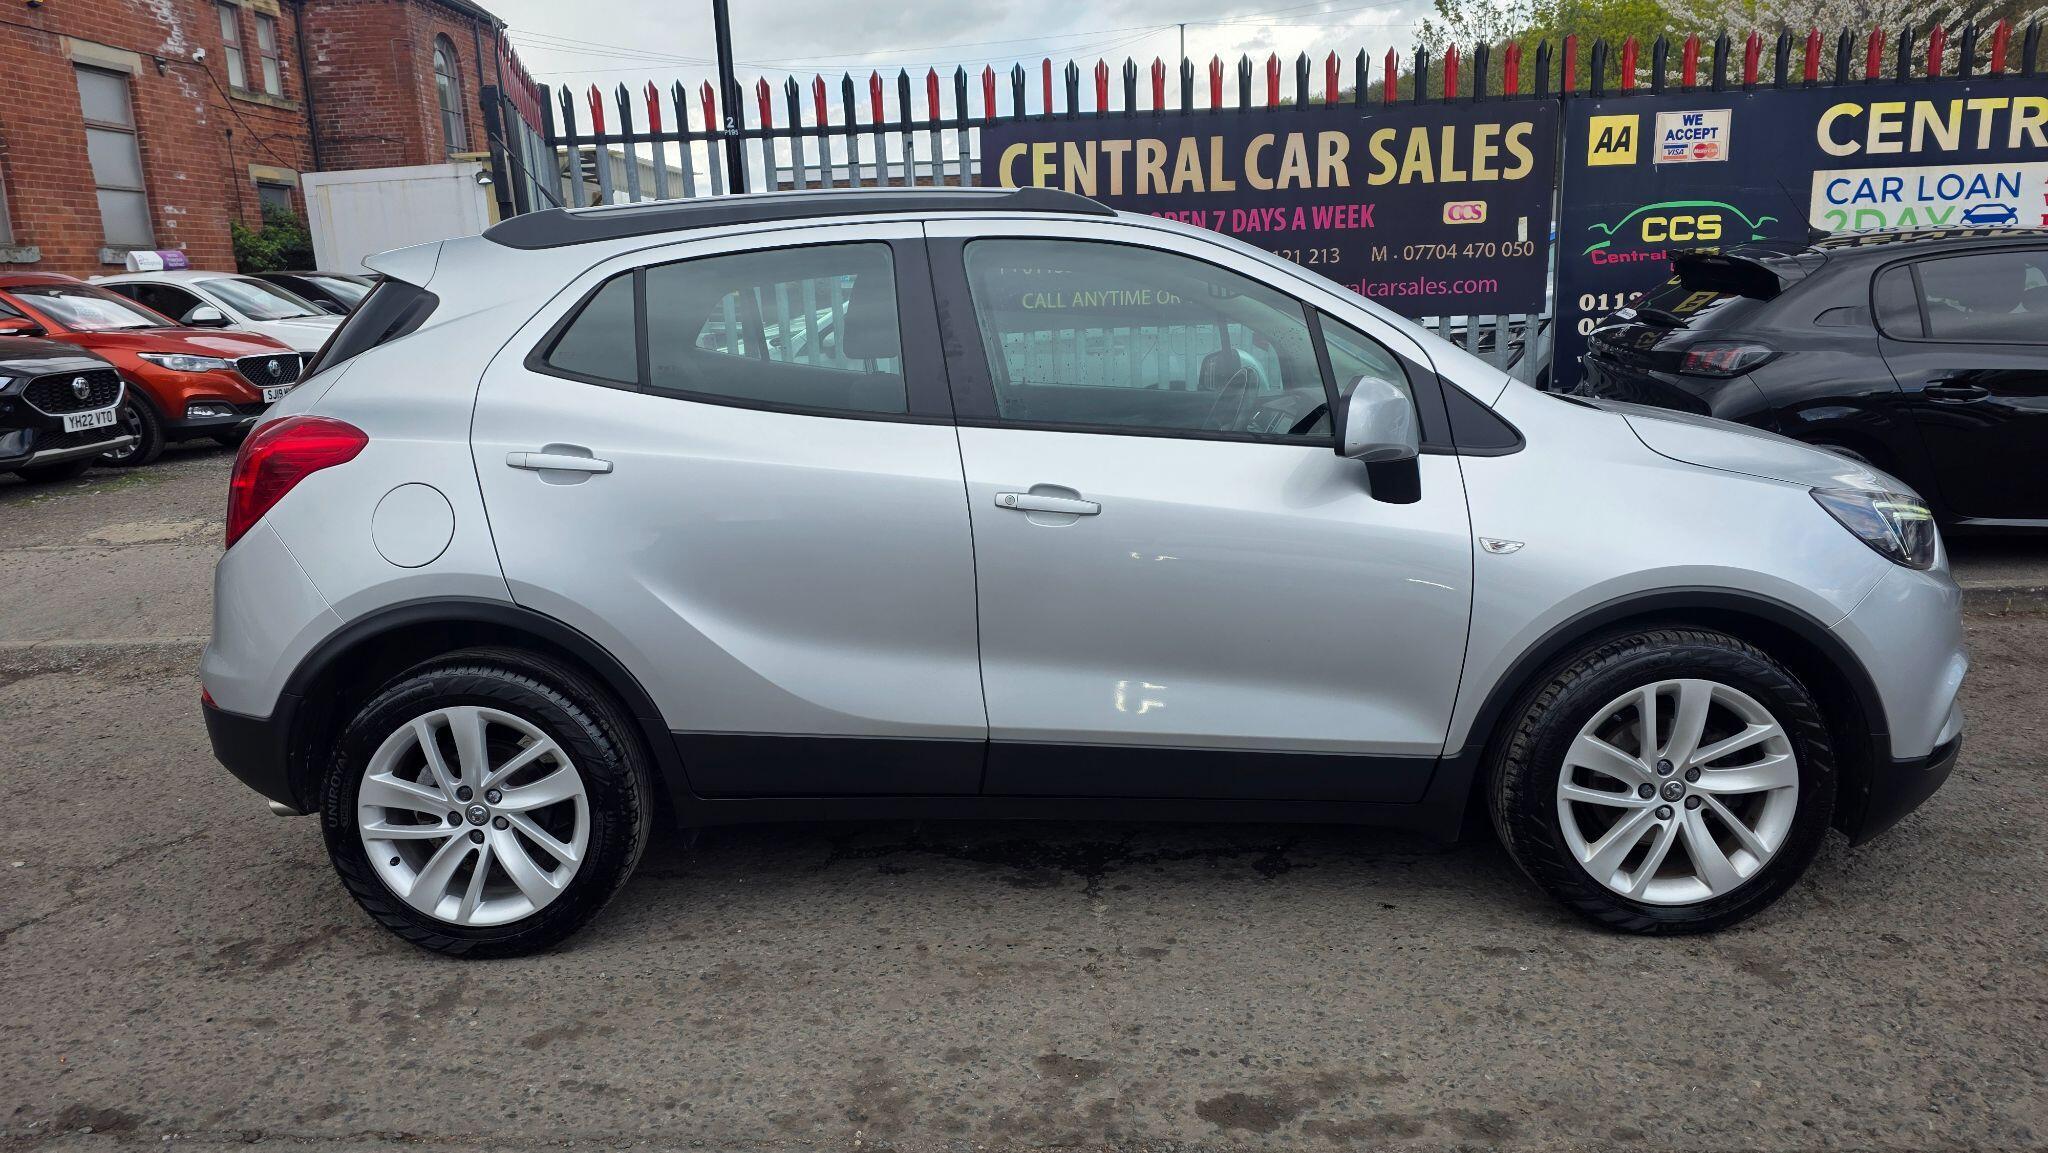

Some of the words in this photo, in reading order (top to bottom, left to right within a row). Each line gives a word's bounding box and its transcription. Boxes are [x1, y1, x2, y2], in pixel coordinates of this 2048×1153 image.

[726, 116, 735, 129] 2
[1683, 114, 1703, 126] WE
[1594, 126, 1631, 153] AA
[1665, 127, 1718, 141] ACCEPT
[999, 136, 1236, 196] CENTRAL
[1244, 131, 1350, 190] CAR
[1367, 122, 1534, 186] SALES
[1826, 176, 1904, 205] CAR
[1917, 172, 2022, 202] LOAN
[1213, 210, 1226, 233] 7
[1232, 207, 1286, 233] DAYS
[1291, 207, 1307, 231] A
[1311, 203, 1376, 230] WEEK
[1448, 204, 1482, 221] CCS
[1641, 214, 1722, 243] CCS
[1308, 247, 1340, 264] 213
[1371, 245, 1387, 262] M
[1403, 243, 1457, 261] 07704
[1463, 242, 1496, 259] 470
[1502, 240, 1535, 257] 050
[1591, 250, 1667, 265] Central
[1022, 292, 1065, 309] CALL
[1072, 290, 1151, 308] ANYTIME
[68, 413, 94, 429] YH22
[95, 410, 113, 425] VTO
